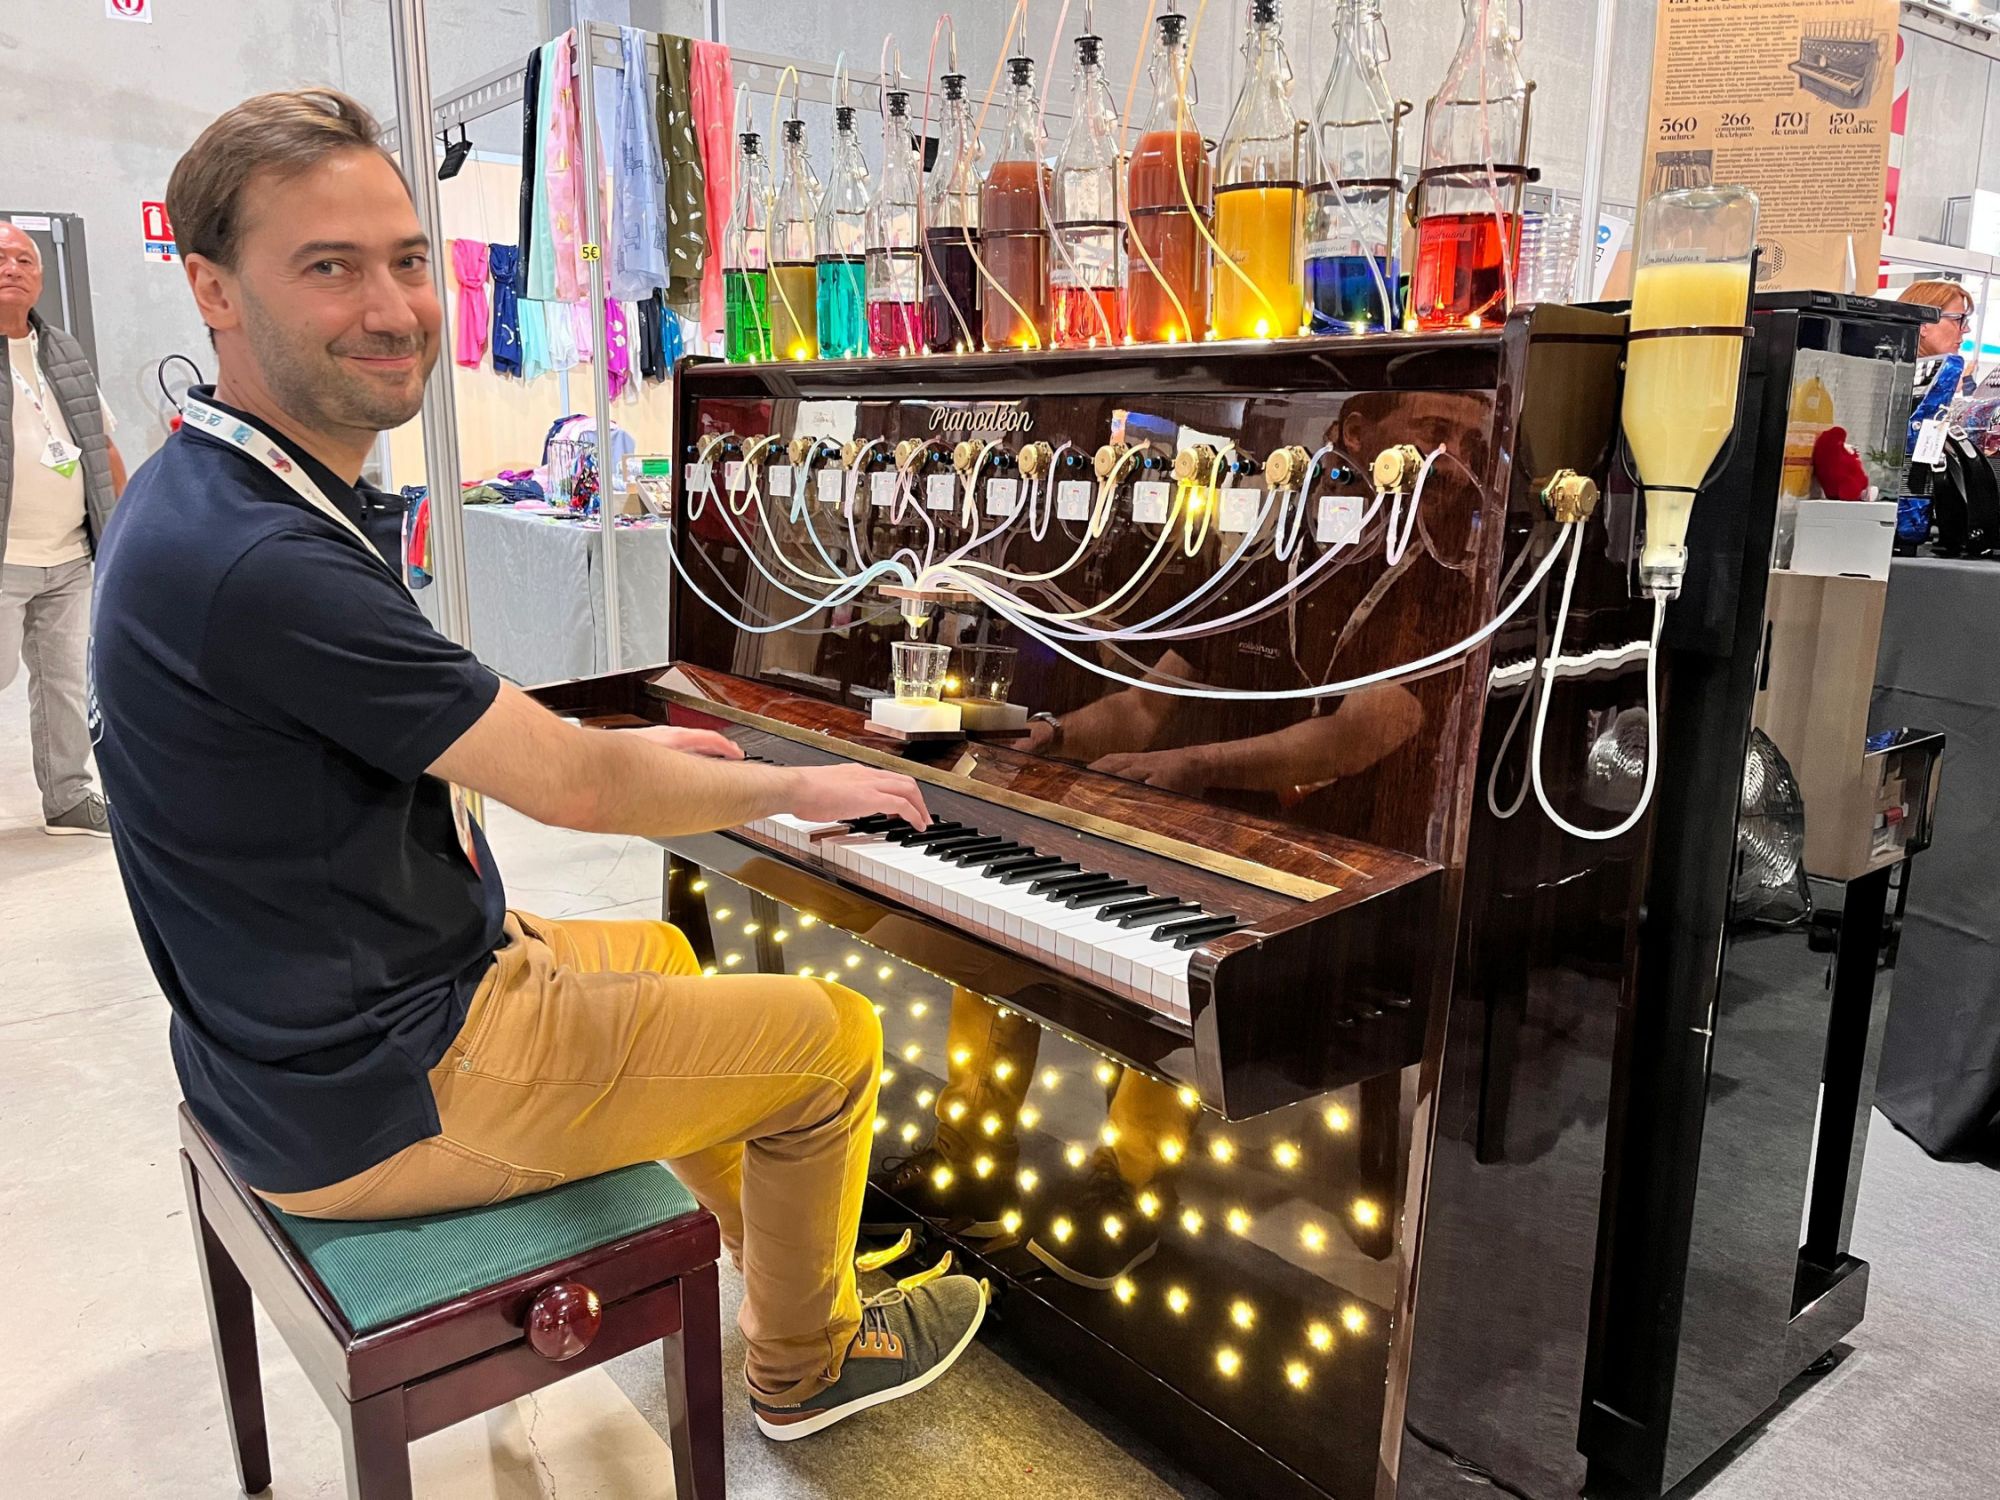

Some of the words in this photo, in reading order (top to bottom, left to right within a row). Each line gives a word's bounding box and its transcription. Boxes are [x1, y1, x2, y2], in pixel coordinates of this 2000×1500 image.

[1660, 116, 1698, 133] 560
[1721, 112, 1751, 126] 266
[1775, 112, 1803, 128] 170
[582, 246, 599, 260] 5€
[928, 403, 1034, 432] Pianodéon
